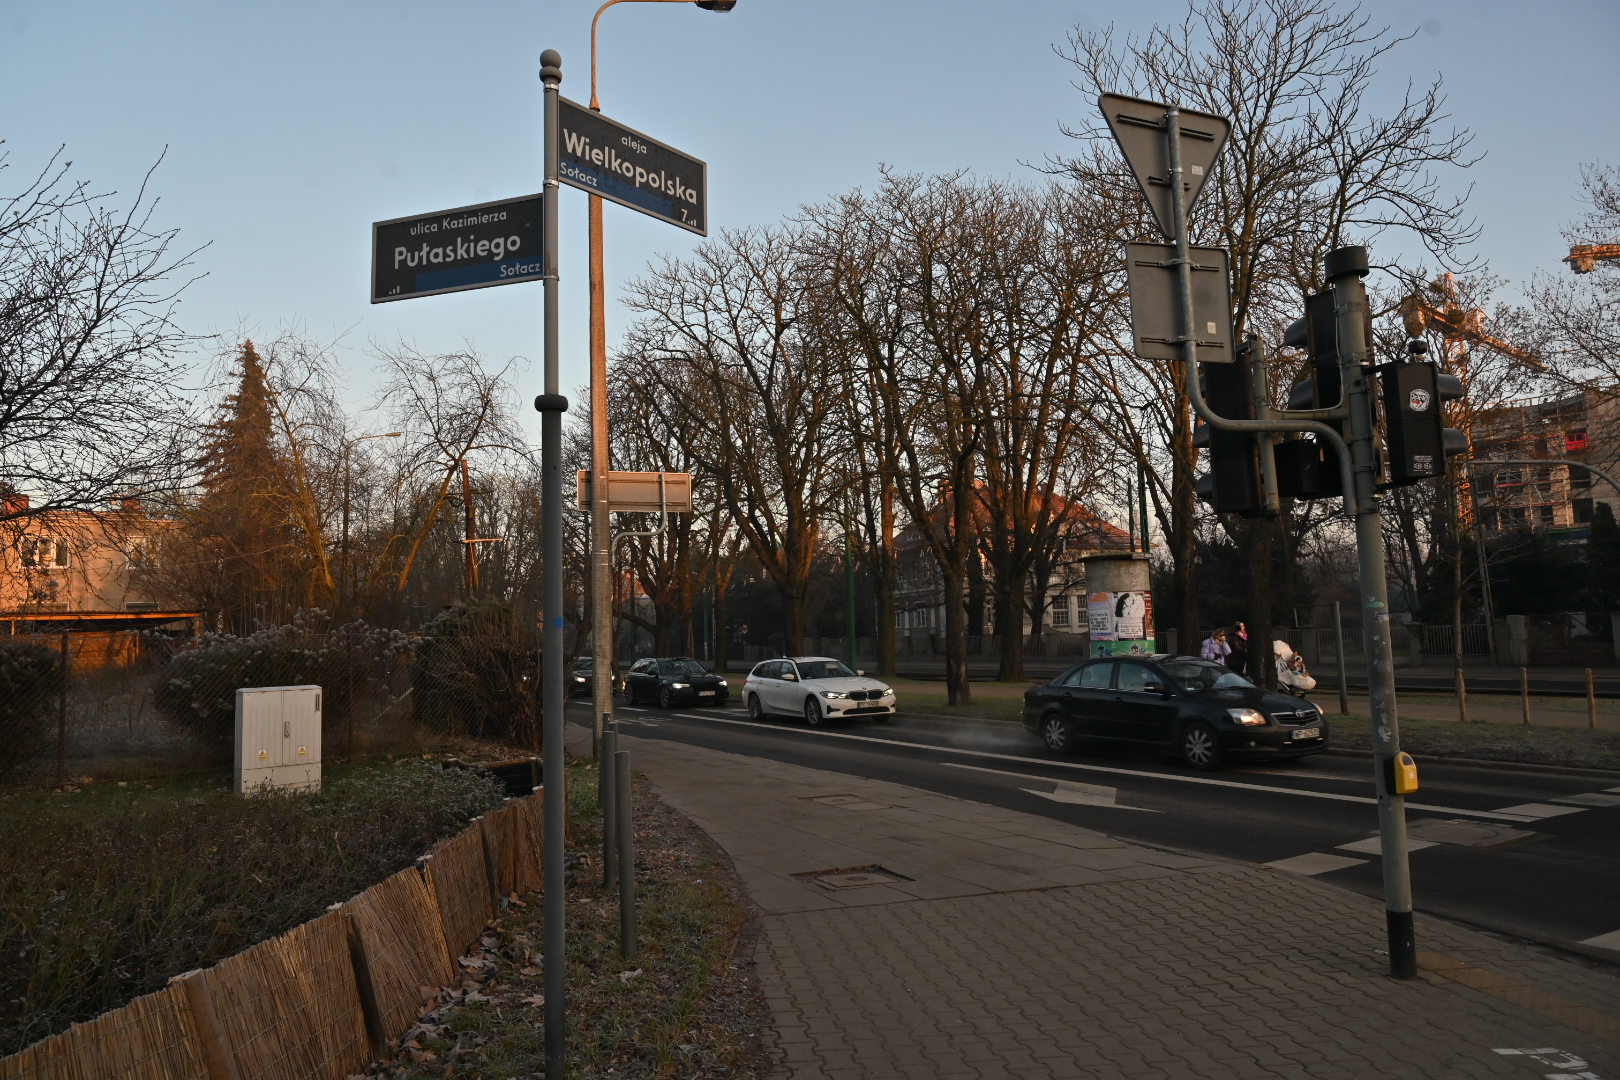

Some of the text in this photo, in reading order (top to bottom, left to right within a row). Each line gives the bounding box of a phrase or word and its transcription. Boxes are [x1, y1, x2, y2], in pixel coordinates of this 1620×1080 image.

[621, 136, 647, 154] aleja
[560, 162, 598, 187] Sołacz
[563, 128, 697, 205] Wielkopolska
[410, 211, 507, 236] ulica Kazimierza
[394, 235, 521, 270] Pułaskiego
[500, 262, 540, 278] Sołacz
